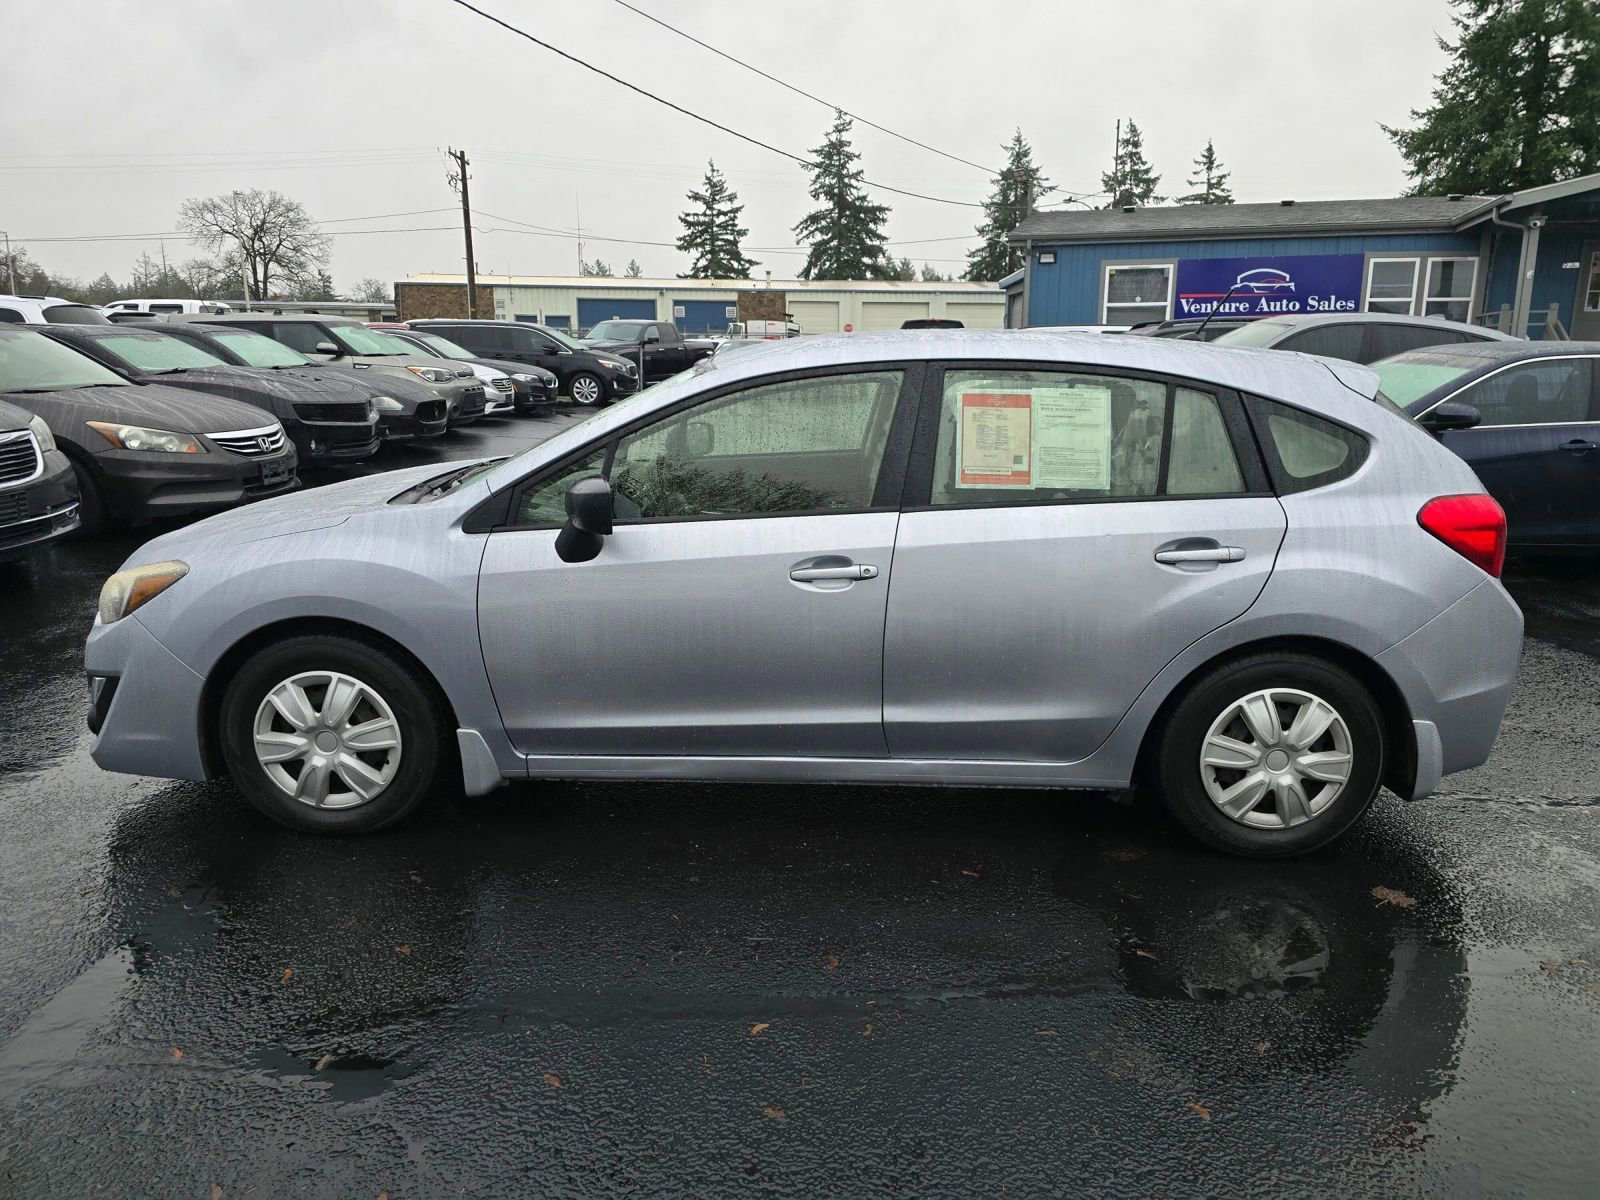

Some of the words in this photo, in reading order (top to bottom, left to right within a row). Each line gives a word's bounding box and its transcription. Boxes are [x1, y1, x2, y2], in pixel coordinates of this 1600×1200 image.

[1180, 298, 1249, 313] Venture
[1256, 296, 1300, 312] Auto
[1307, 294, 1355, 311] Sales
